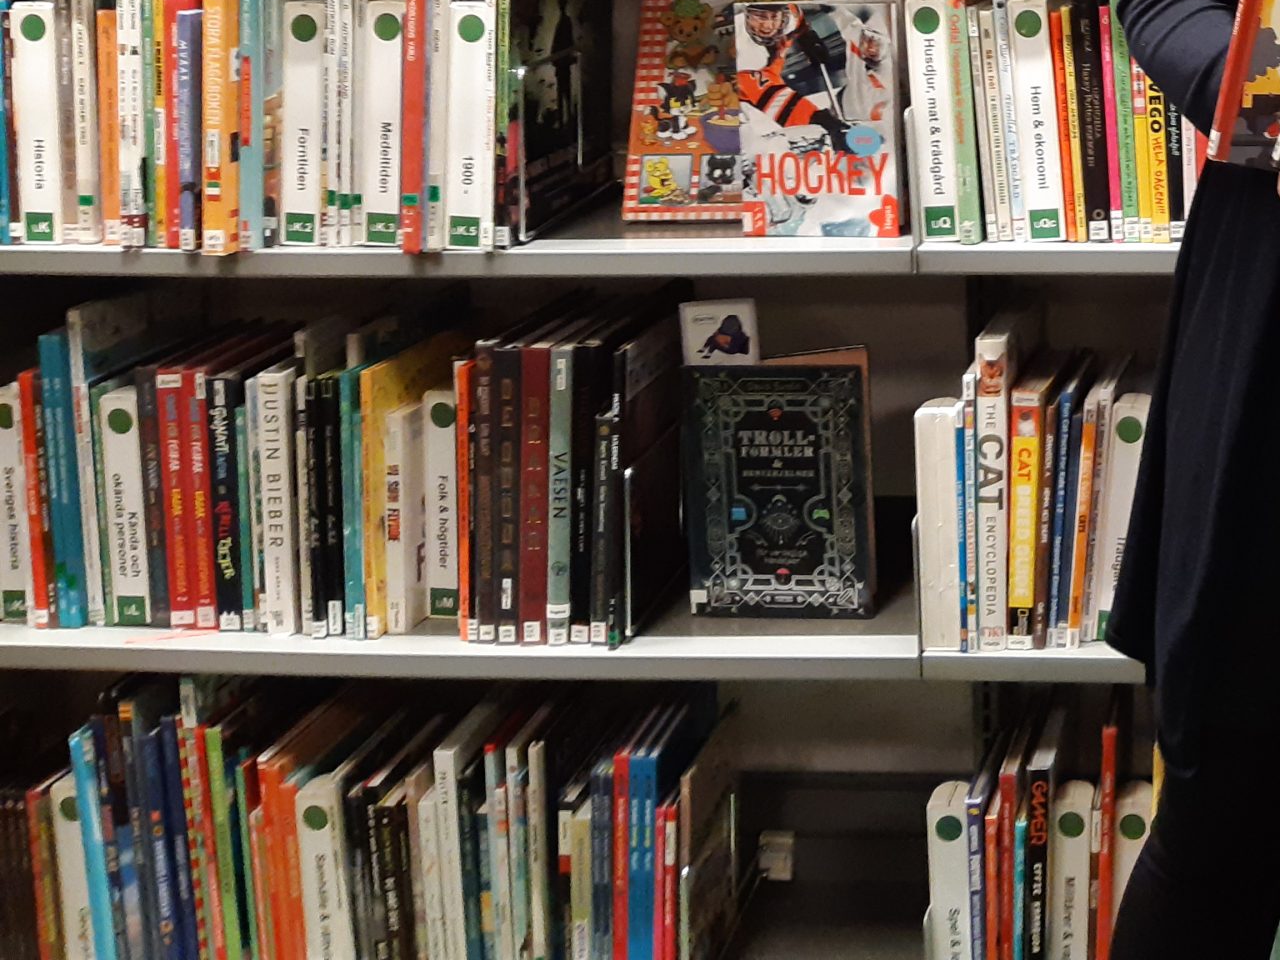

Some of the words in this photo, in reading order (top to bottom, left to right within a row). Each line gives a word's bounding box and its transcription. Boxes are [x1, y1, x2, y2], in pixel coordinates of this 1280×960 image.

[206, 5, 223, 46] STORA
[206, 47, 222, 125] FLAGGBOKEN
[922, 37, 940, 94] Husdjur,
[928, 96, 939, 123] mat
[1029, 84, 1043, 117] Hem
[1033, 119, 1045, 130] &
[929, 126, 939, 137] &
[1151, 136, 1164, 167] HELA
[32, 138, 46, 191] Historia
[296, 127, 311, 192] Forntiden
[378, 121, 393, 195] Medeltiden
[461, 155, 475, 186] 1900
[754, 149, 889, 197] HOCKEY
[929, 138, 947, 197] trädgård
[1032, 132, 1049, 191] ekonomi
[737, 429, 816, 446] TROLL-
[984, 403, 998, 429] THE
[738, 445, 814, 458] FORMLER
[977, 432, 1004, 511] CAT
[1016, 446, 1032, 483] CAT
[3, 465, 20, 522] Sveriges
[110, 472, 126, 520] okända
[436, 474, 451, 502] Folk
[437, 504, 450, 514] &
[551, 450, 570, 521] VAESEN
[126, 511, 141, 551] Kända
[264, 472, 286, 549] BIEBER
[8, 523, 22, 572] historia
[112, 521, 129, 578] personer
[130, 554, 142, 578] och
[435, 517, 451, 570] högtider
[984, 515, 998, 617] ENCYCLOPEDIA
[1030, 779, 1048, 847] GAMER
[946, 907, 963, 937] Spel
[1061, 876, 1077, 931] Militärer
[1063, 931, 1076, 943] &
